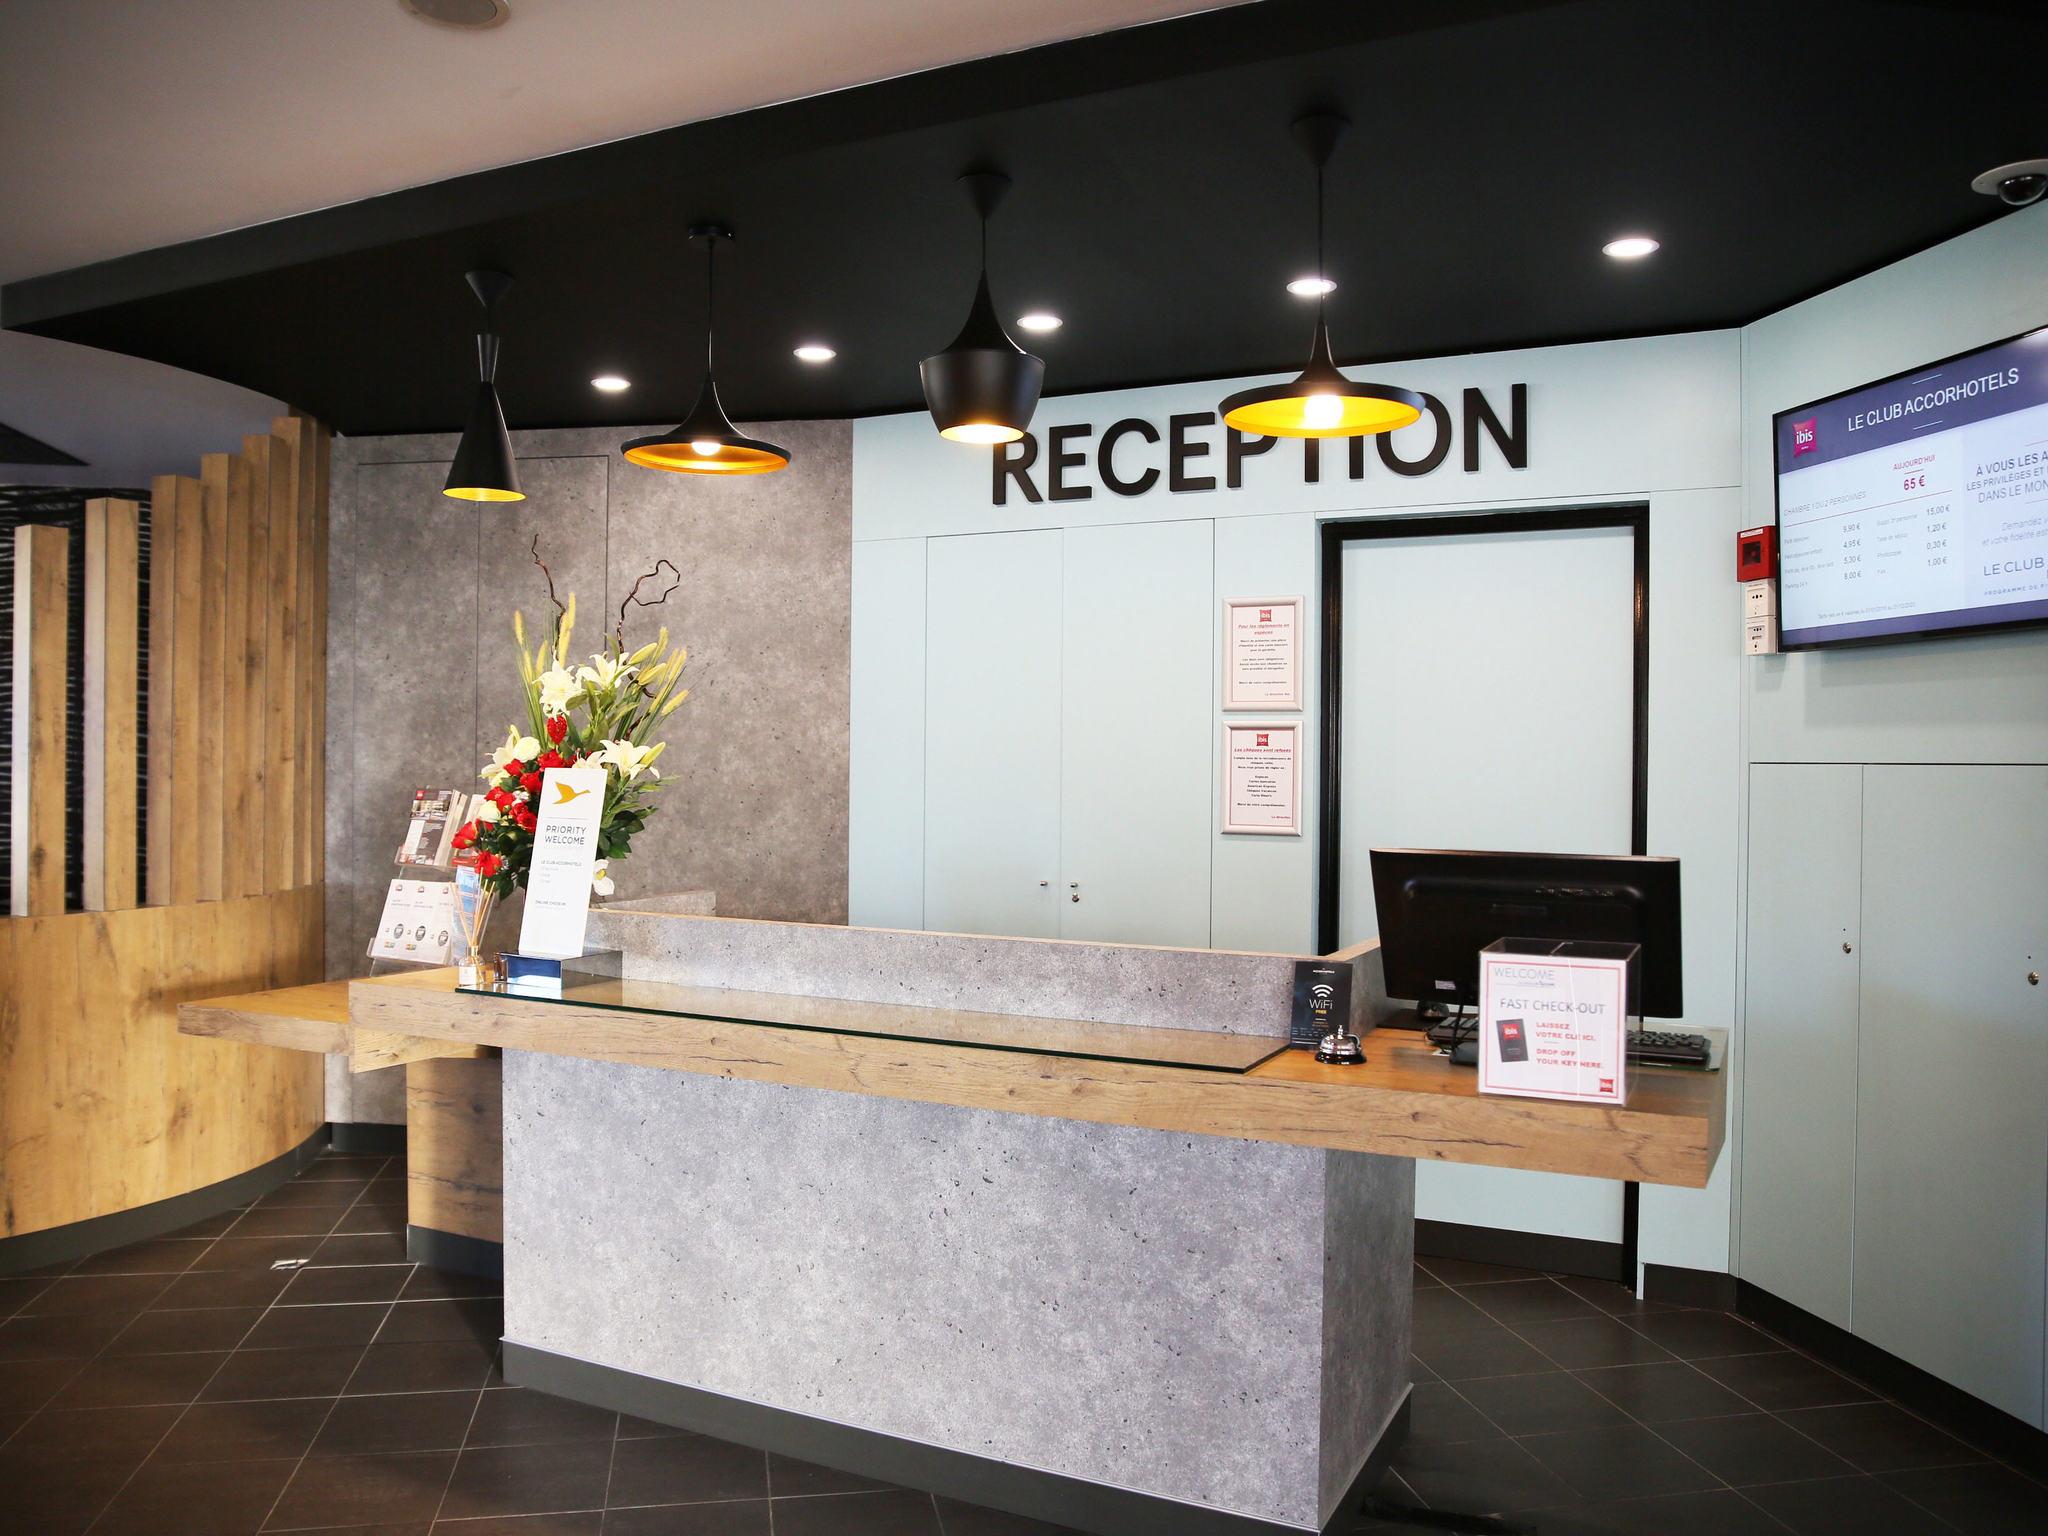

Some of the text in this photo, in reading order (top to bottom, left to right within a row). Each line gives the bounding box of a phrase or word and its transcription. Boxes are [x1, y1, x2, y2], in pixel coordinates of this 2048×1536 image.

[1847, 367, 2020, 432] LE CLUB ACCORHOTELS
[1796, 428, 1813, 445] ibis
[1892, 454, 1937, 471] AUJOURD'HUI
[1986, 458, 2016, 474] VOUS
[2017, 453, 2039, 468] LES
[1903, 475, 1926, 491] 65 €
[1966, 481, 1982, 492] LES
[2033, 466, 2044, 477] ET
[1978, 487, 2007, 504] DANS
[2008, 484, 2022, 498] LE
[1983, 557, 2045, 577] LE CLUB
[1983, 586, 2026, 596] PROGRAMME
[545, 825, 587, 835] PRIORITY
[544, 835, 585, 845] WELCOME
[1494, 966, 1555, 981] WELCOME
[1309, 999, 1333, 1010] WiFi
[1499, 998, 1606, 1015] FAST CHECK-OUT
[1536, 1022, 1570, 1030] LAISSEZ
[1535, 1031, 1563, 1039] VOTRE
[1536, 1048, 1577, 1057] DROP OFF
[1536, 1057, 1560, 1066] YOUR
[1560, 1058, 1578, 1067] KEY
